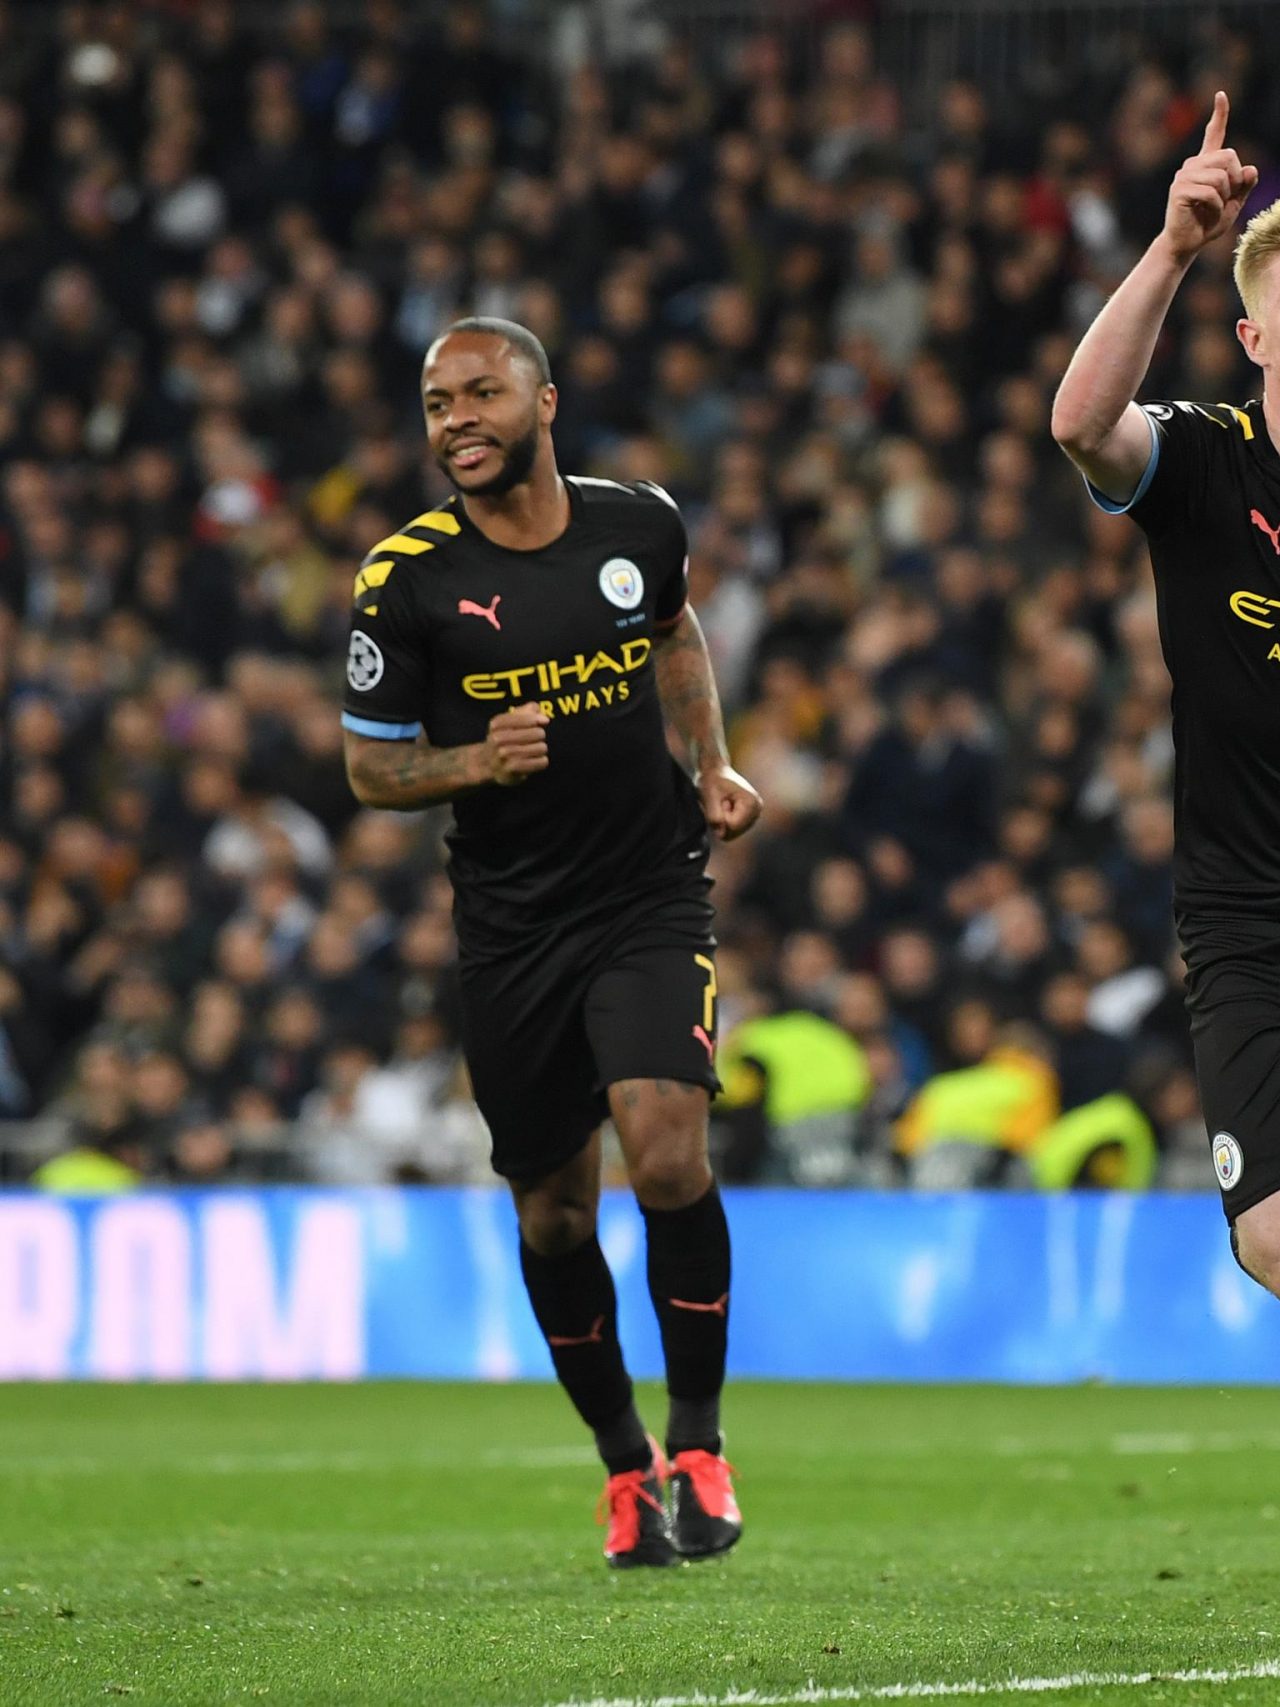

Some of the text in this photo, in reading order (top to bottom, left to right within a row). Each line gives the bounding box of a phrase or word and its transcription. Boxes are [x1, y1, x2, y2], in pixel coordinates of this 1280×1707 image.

[462, 637, 652, 700] ETIHAD
[508, 680, 630, 718] RWAYS
[694, 953, 717, 1031] 7
